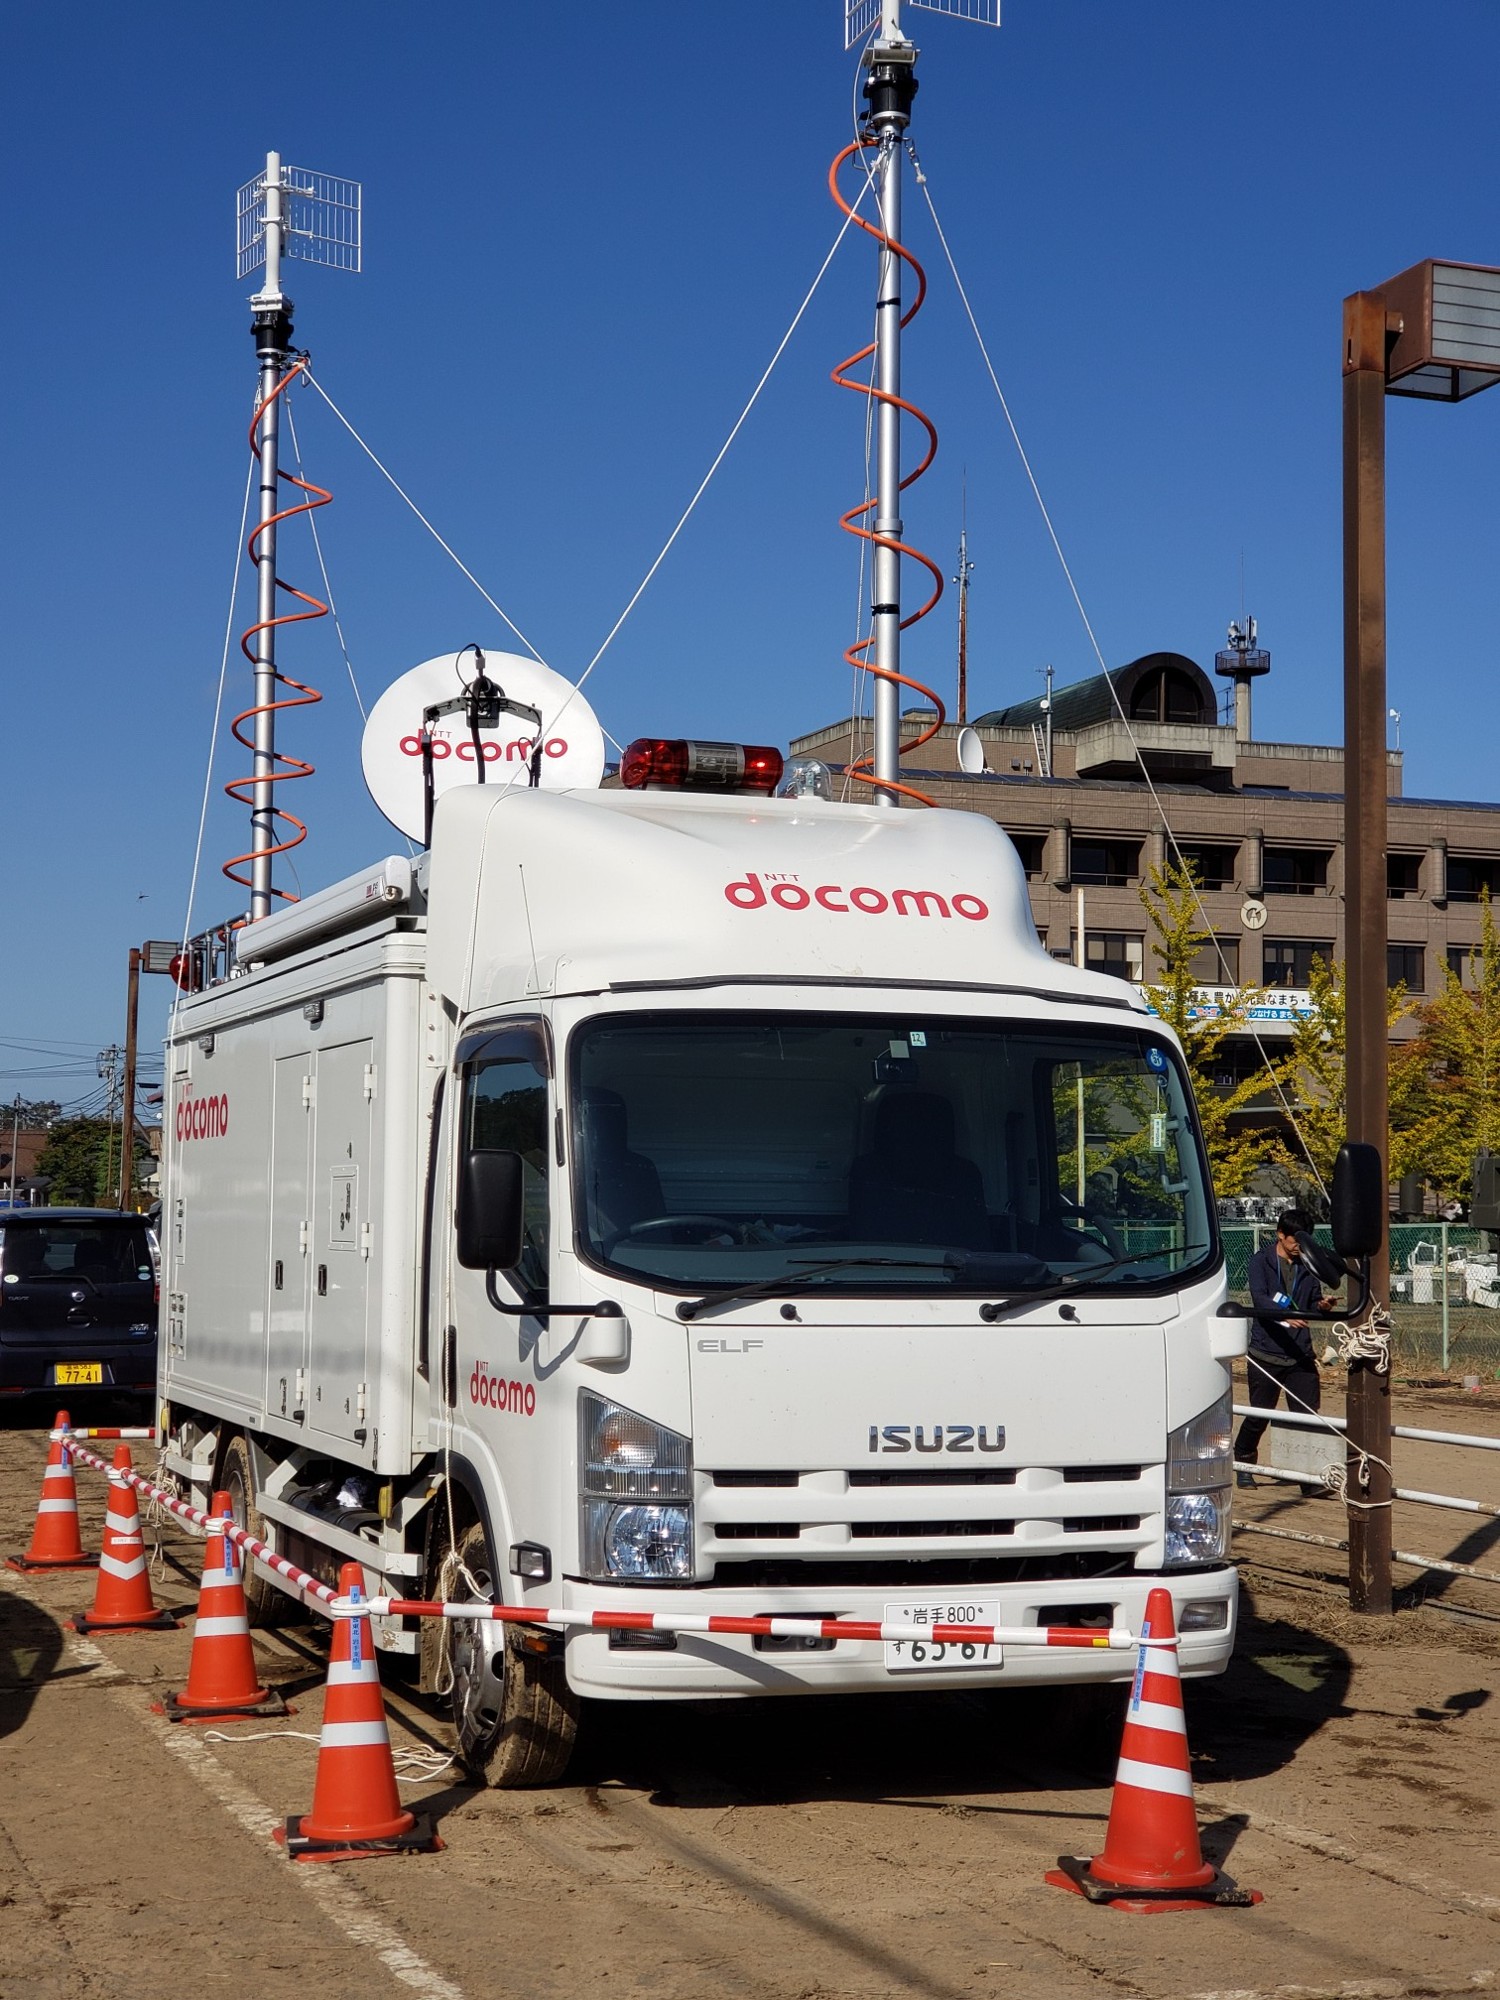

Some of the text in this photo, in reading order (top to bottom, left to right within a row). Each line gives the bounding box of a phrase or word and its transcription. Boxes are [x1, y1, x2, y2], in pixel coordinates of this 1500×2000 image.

[399, 728, 568, 762] docomo
[764, 873, 800, 881] NTT
[724, 873, 989, 921] docomo
[177, 1084, 228, 1142] docomo
[697, 1339, 764, 1353] ELF
[65, 1370, 98, 1383] 77-41
[470, 1360, 535, 1416] docomo
[868, 1425, 1006, 1453] ISUZU
